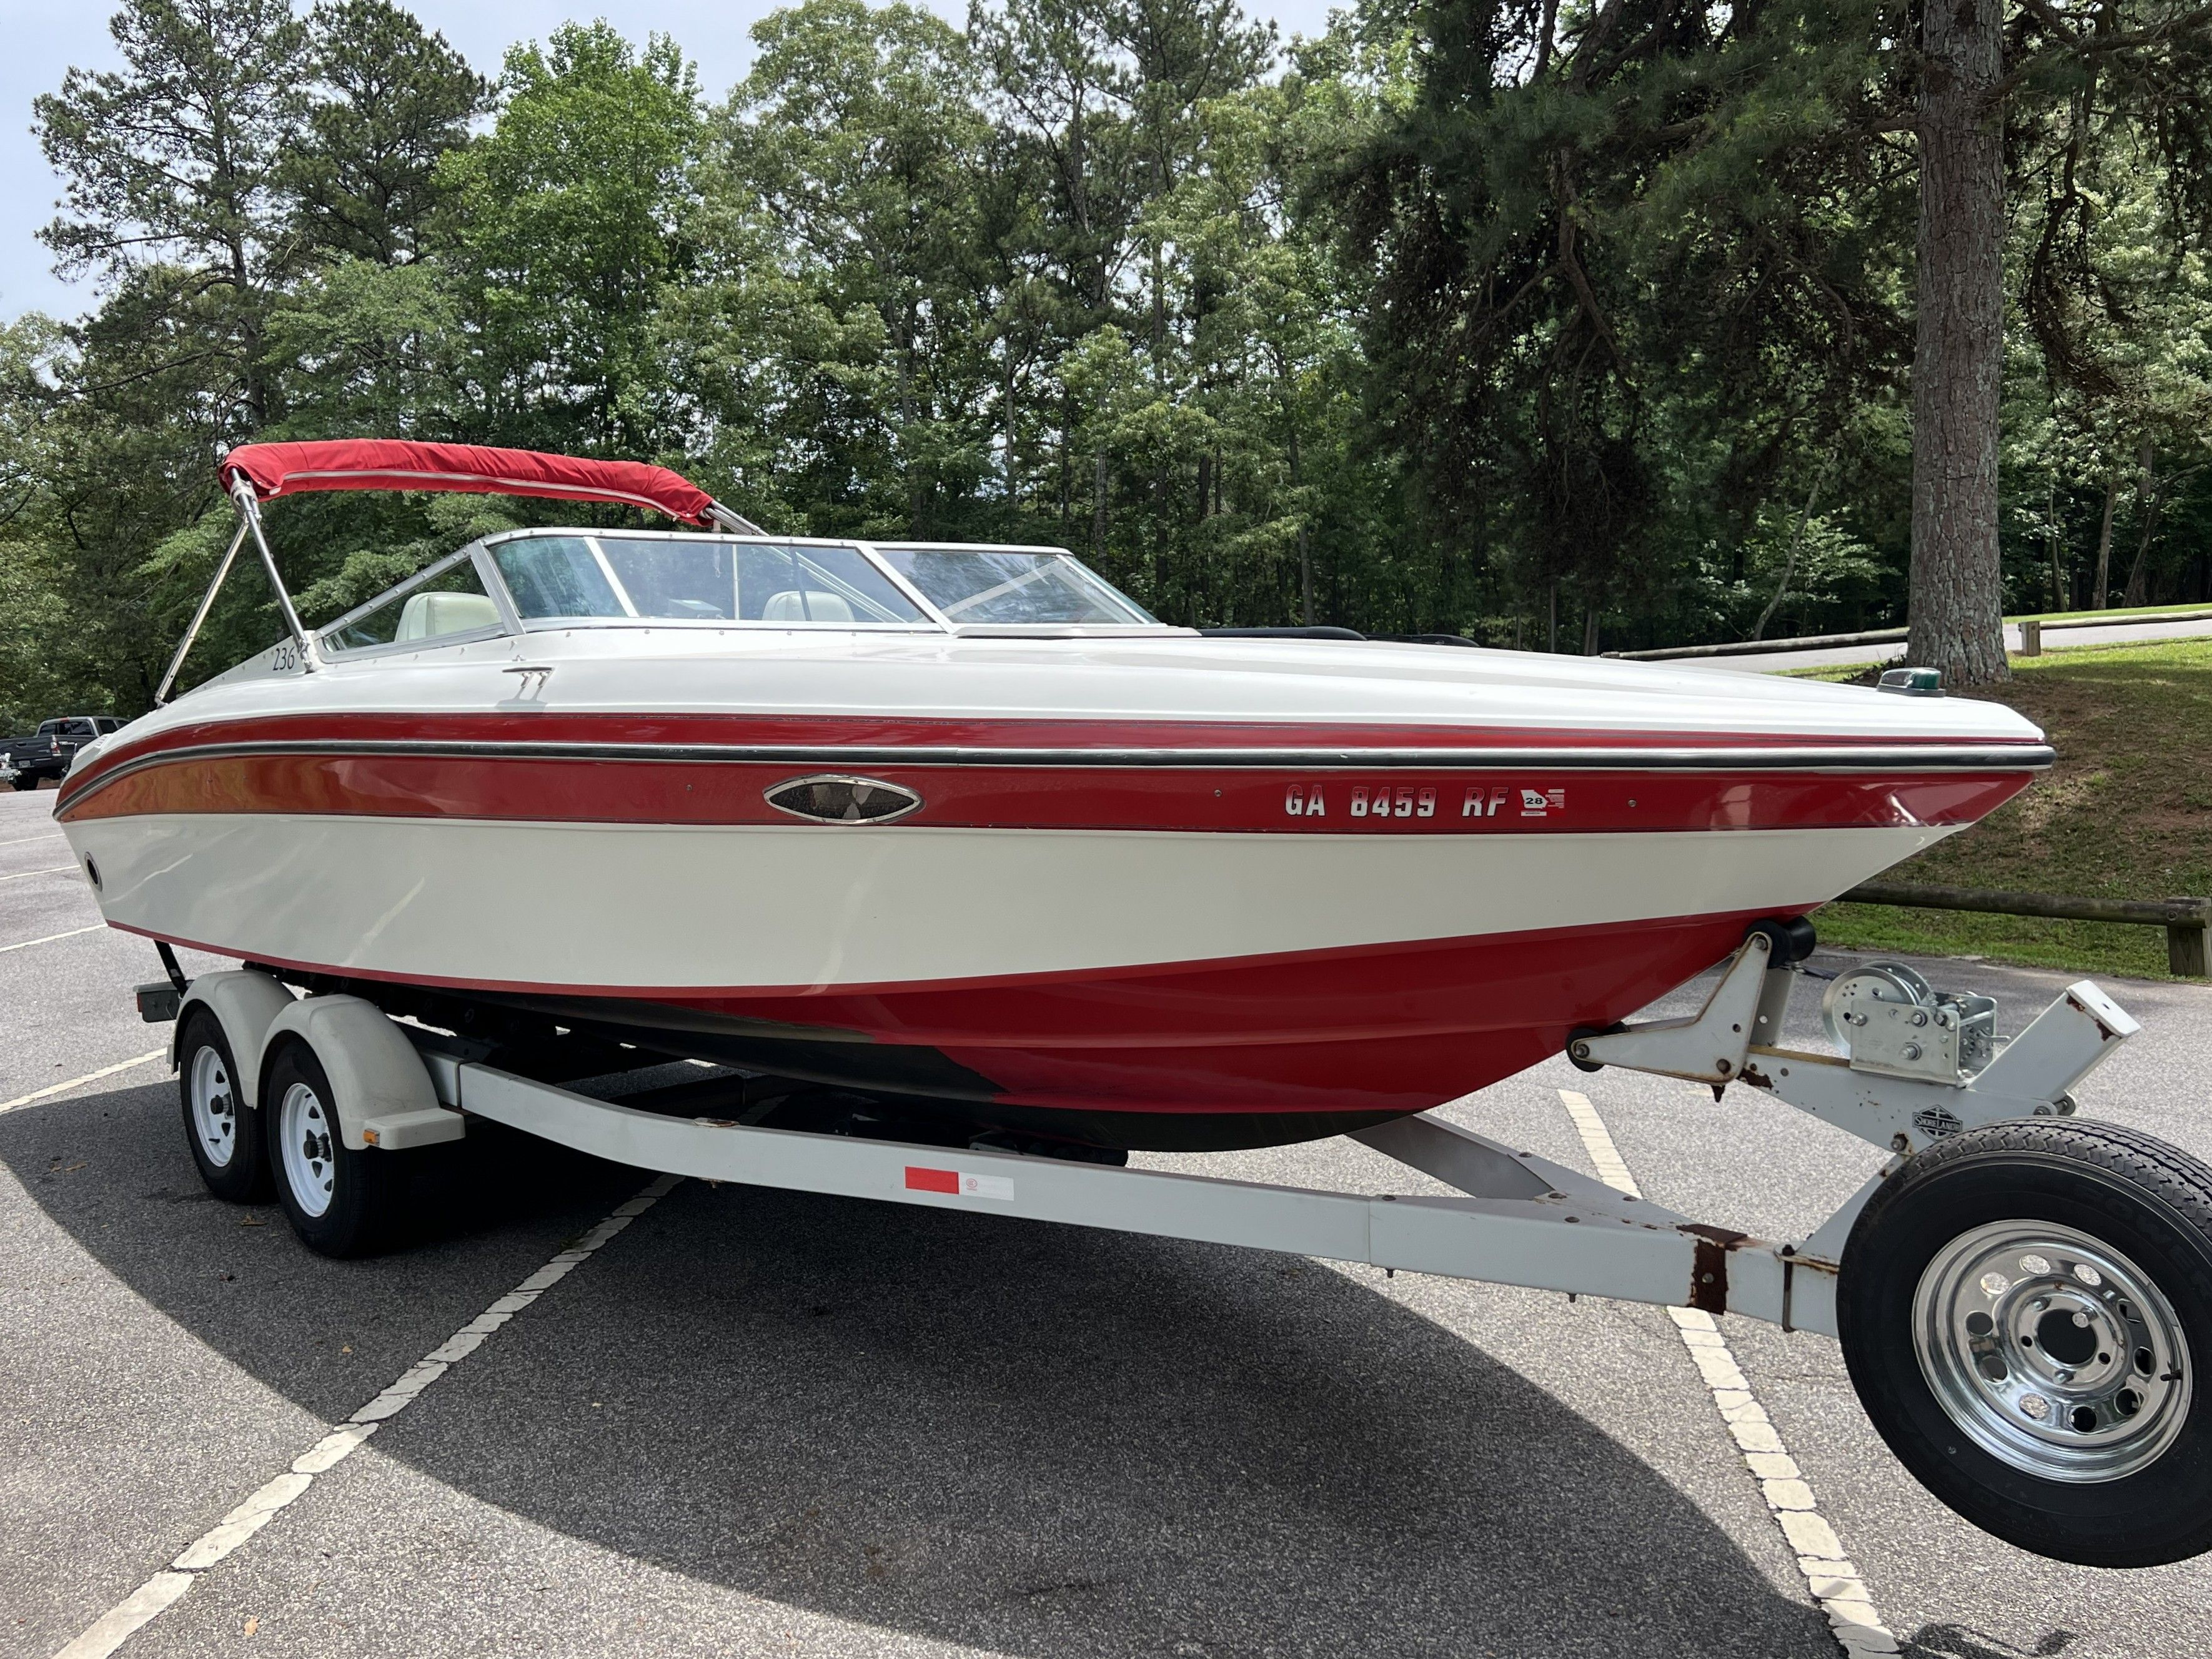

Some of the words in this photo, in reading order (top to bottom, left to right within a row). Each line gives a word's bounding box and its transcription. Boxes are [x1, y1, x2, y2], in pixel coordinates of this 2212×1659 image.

[273, 646, 294, 671] 236
[1285, 785, 1326, 816] GA
[1350, 786, 1437, 817] 8459
[1461, 787, 1509, 817] RF
